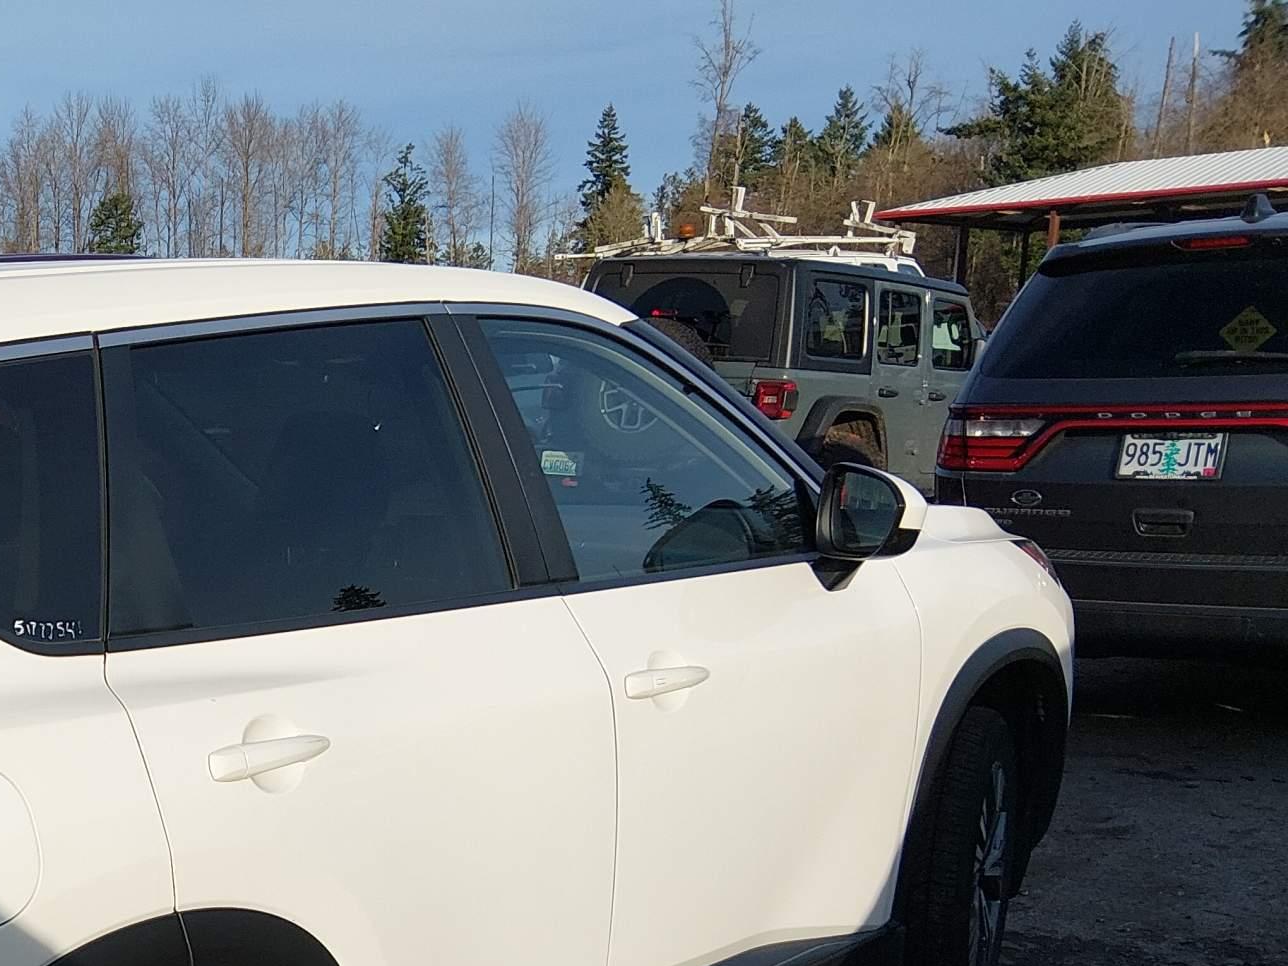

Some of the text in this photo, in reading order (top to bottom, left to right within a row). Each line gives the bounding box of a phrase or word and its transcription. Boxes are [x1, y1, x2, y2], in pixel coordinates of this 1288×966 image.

[1098, 411, 1252, 419] DODGE
[1124, 442, 1219, 467] 985 JTM
